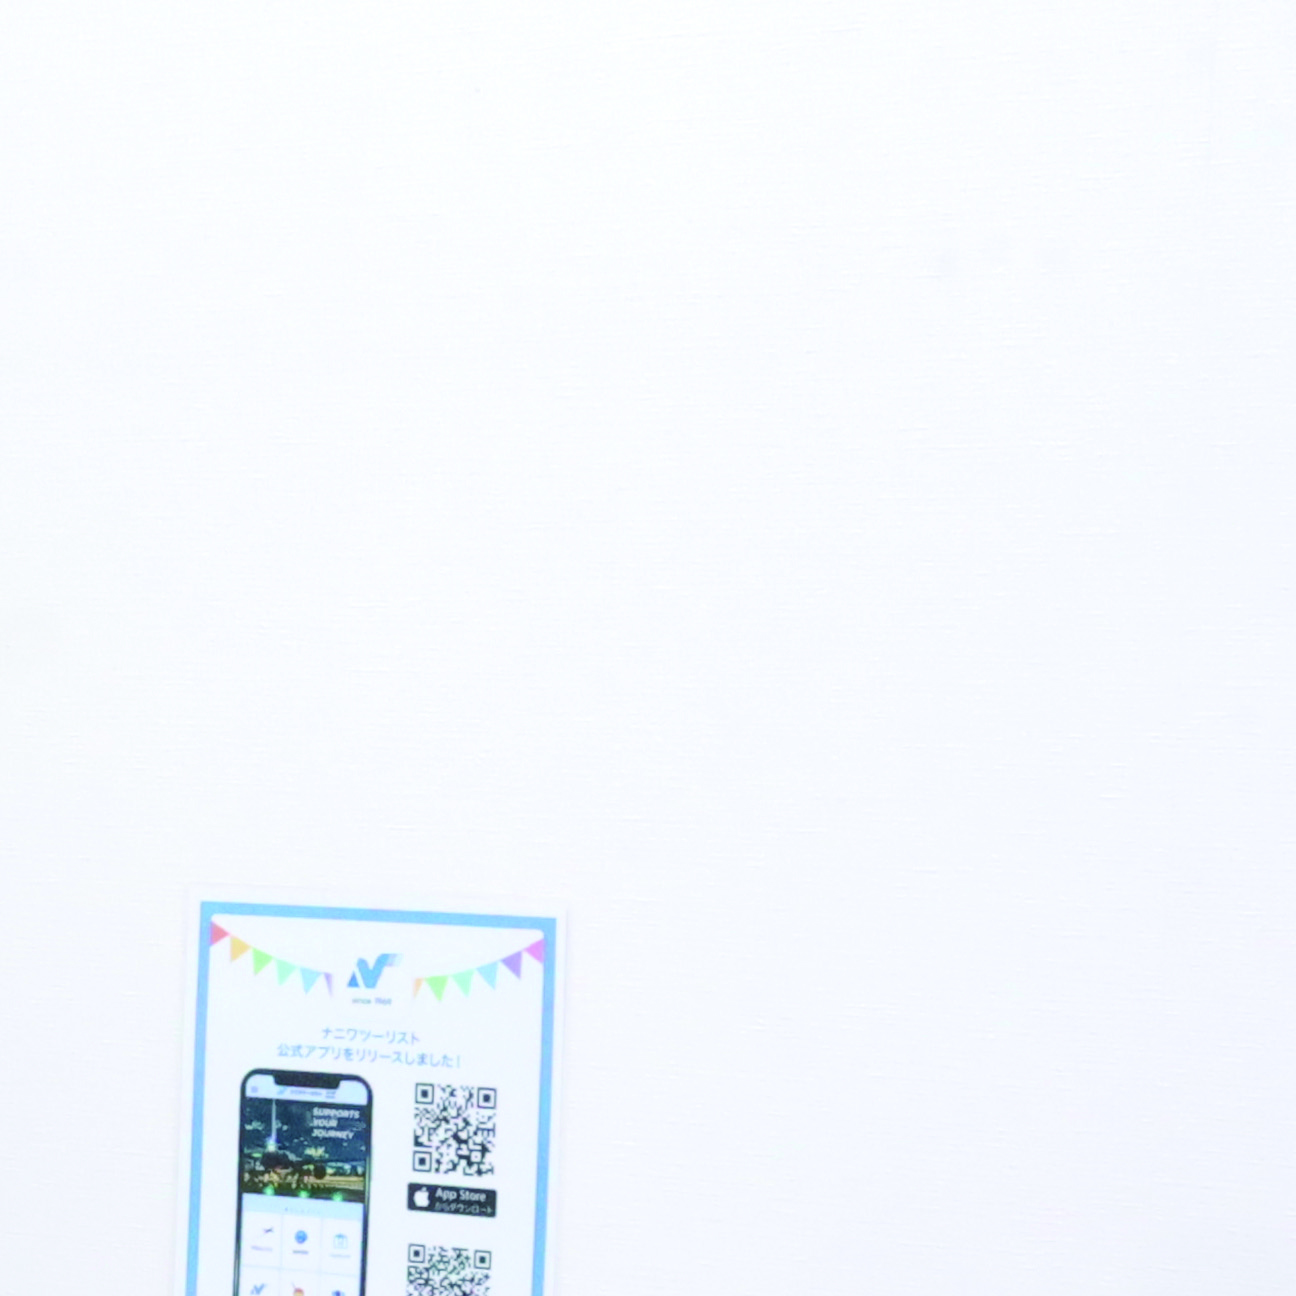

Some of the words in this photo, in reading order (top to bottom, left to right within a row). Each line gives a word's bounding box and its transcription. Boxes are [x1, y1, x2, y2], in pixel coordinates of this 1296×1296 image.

[321, 1026, 420, 1046] ナニワツーリスト
[312, 1106, 360, 1119] SUPPORTS
[312, 1117, 338, 1128] YOUR
[311, 1128, 354, 1140] JOURNEY
[435, 1187, 458, 1202] App
[459, 1189, 487, 1203] Store
